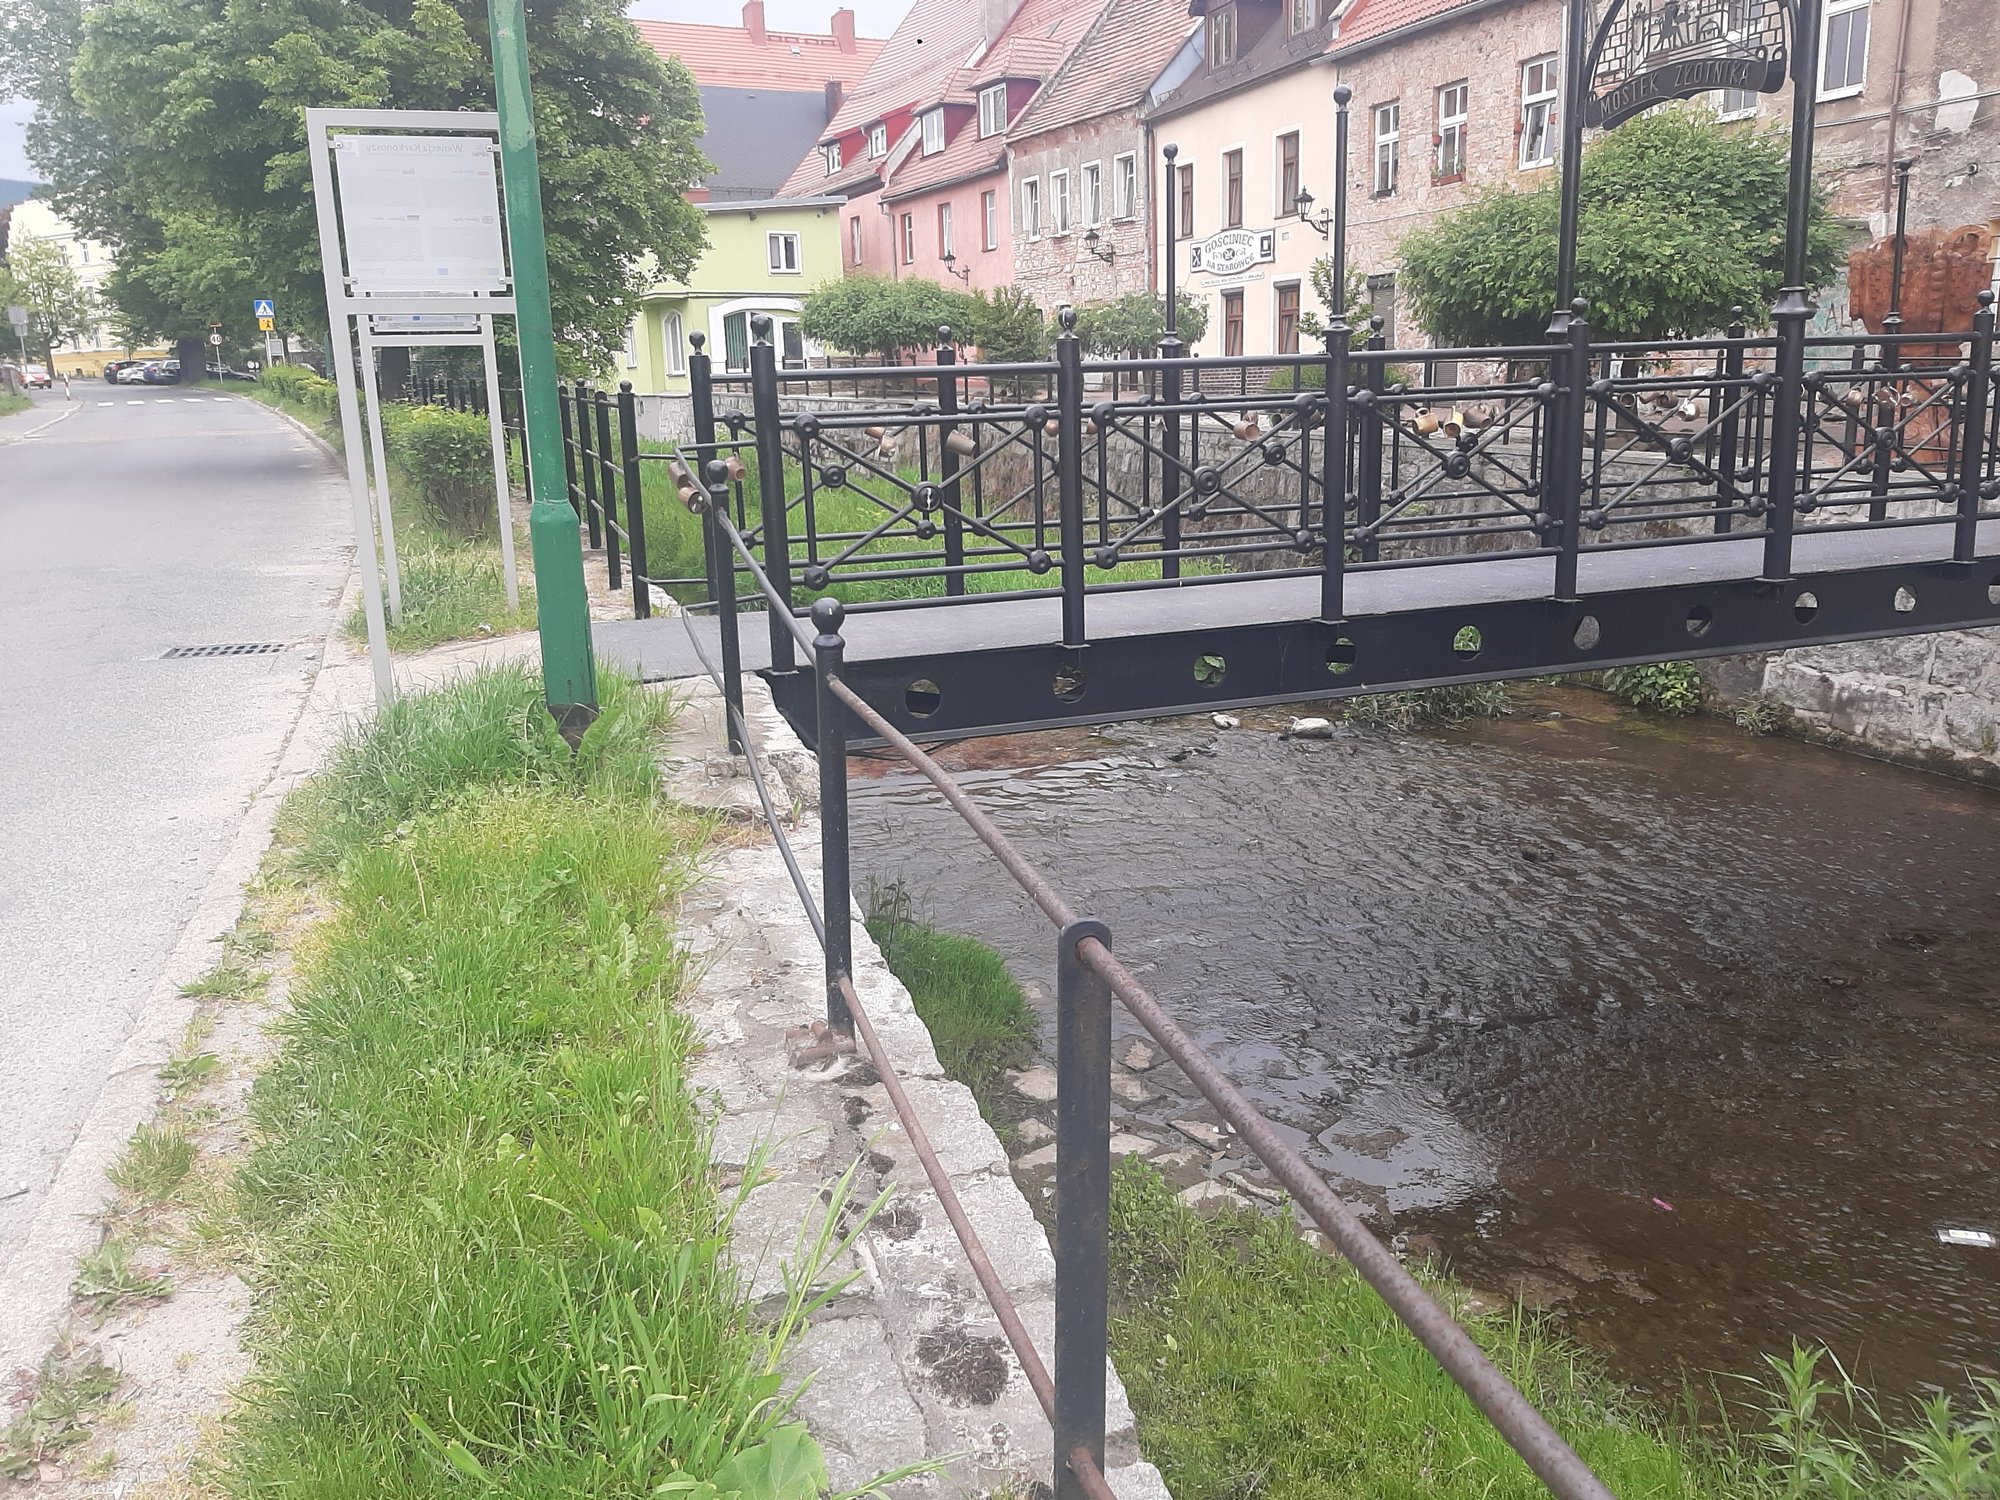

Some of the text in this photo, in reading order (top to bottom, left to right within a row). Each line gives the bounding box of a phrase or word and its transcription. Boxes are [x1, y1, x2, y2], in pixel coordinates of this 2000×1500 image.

[1601, 61, 1750, 116] MOSTEK ZŁOTNIKA
[1204, 234, 1254, 254] GOŚCINIEC
[1206, 260, 1216, 270] NA
[211, 335, 221, 343] 40
